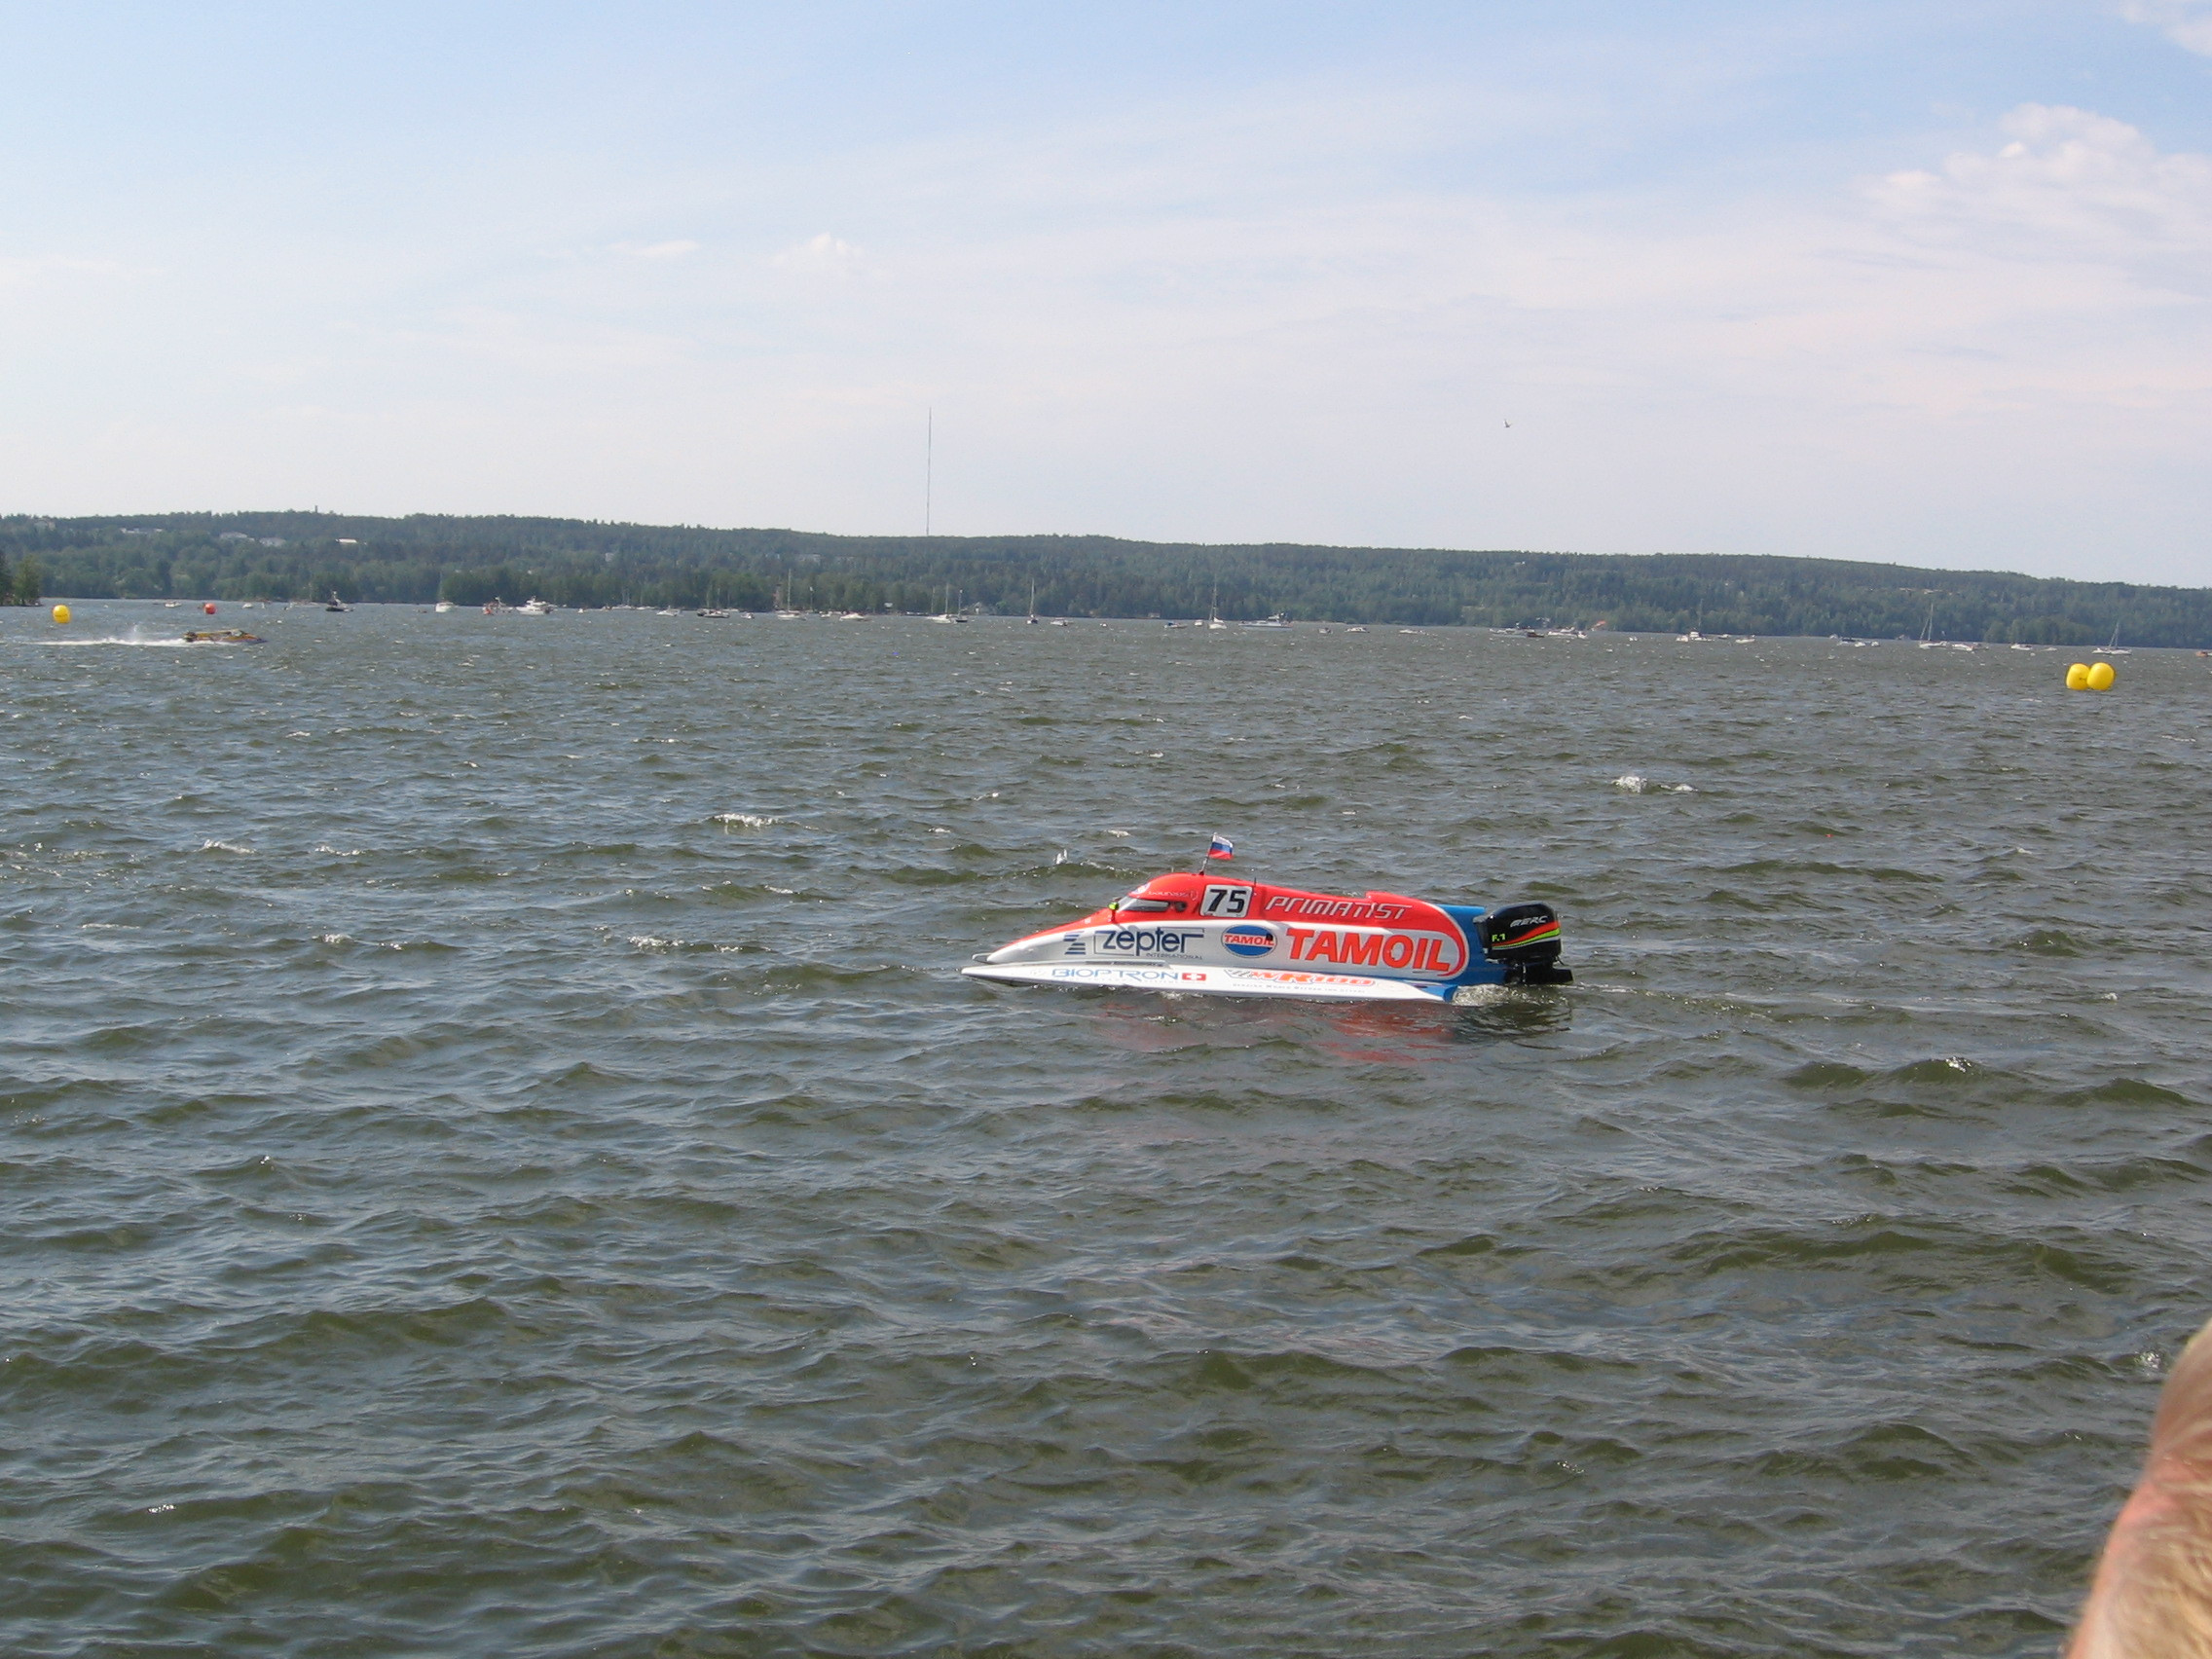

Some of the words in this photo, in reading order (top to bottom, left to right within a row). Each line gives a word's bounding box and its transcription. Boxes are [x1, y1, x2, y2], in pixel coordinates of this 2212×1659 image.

[1207, 888, 1247, 913] 75
[1095, 927, 1204, 956] zepter
[1286, 927, 1452, 973] TAMOIL
[1051, 968, 1179, 981] BIOPTRON
